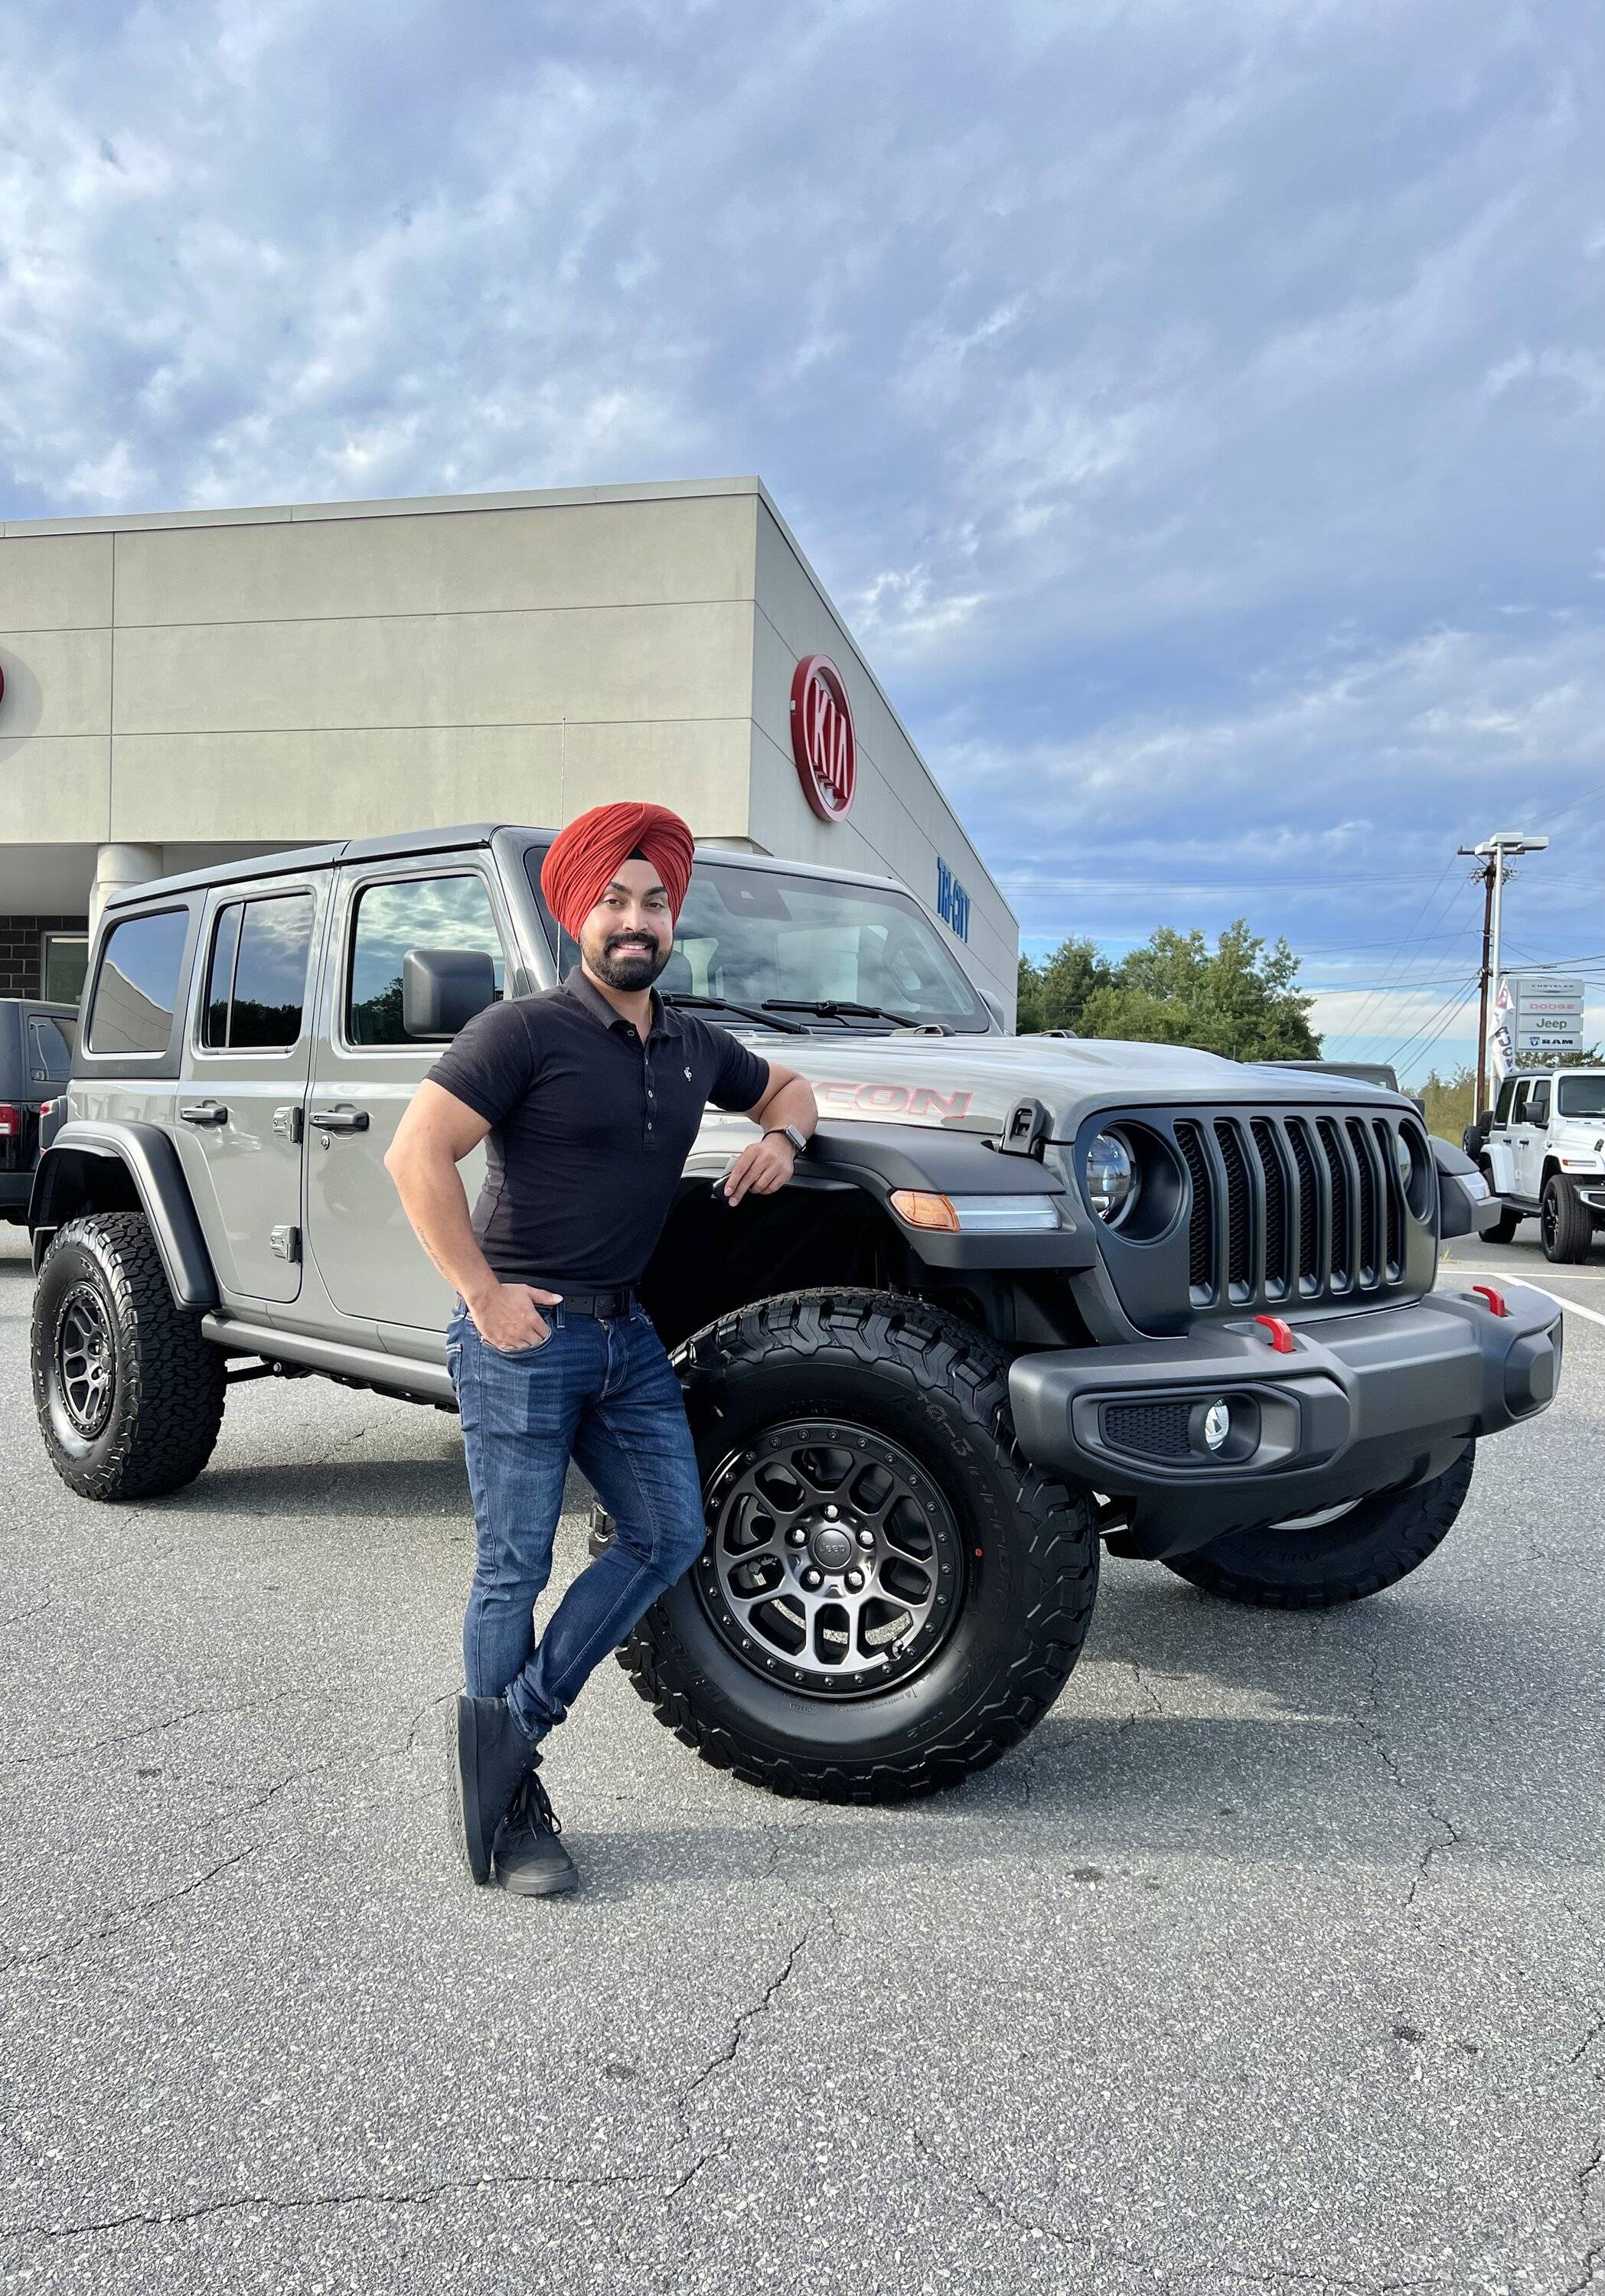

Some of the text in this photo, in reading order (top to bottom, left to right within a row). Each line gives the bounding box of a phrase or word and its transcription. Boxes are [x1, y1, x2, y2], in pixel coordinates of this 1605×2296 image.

[811, 677, 848, 799] KIA
[937, 856, 971, 943] TRI-CITY
[1536, 1018, 1567, 1030] Jeep
